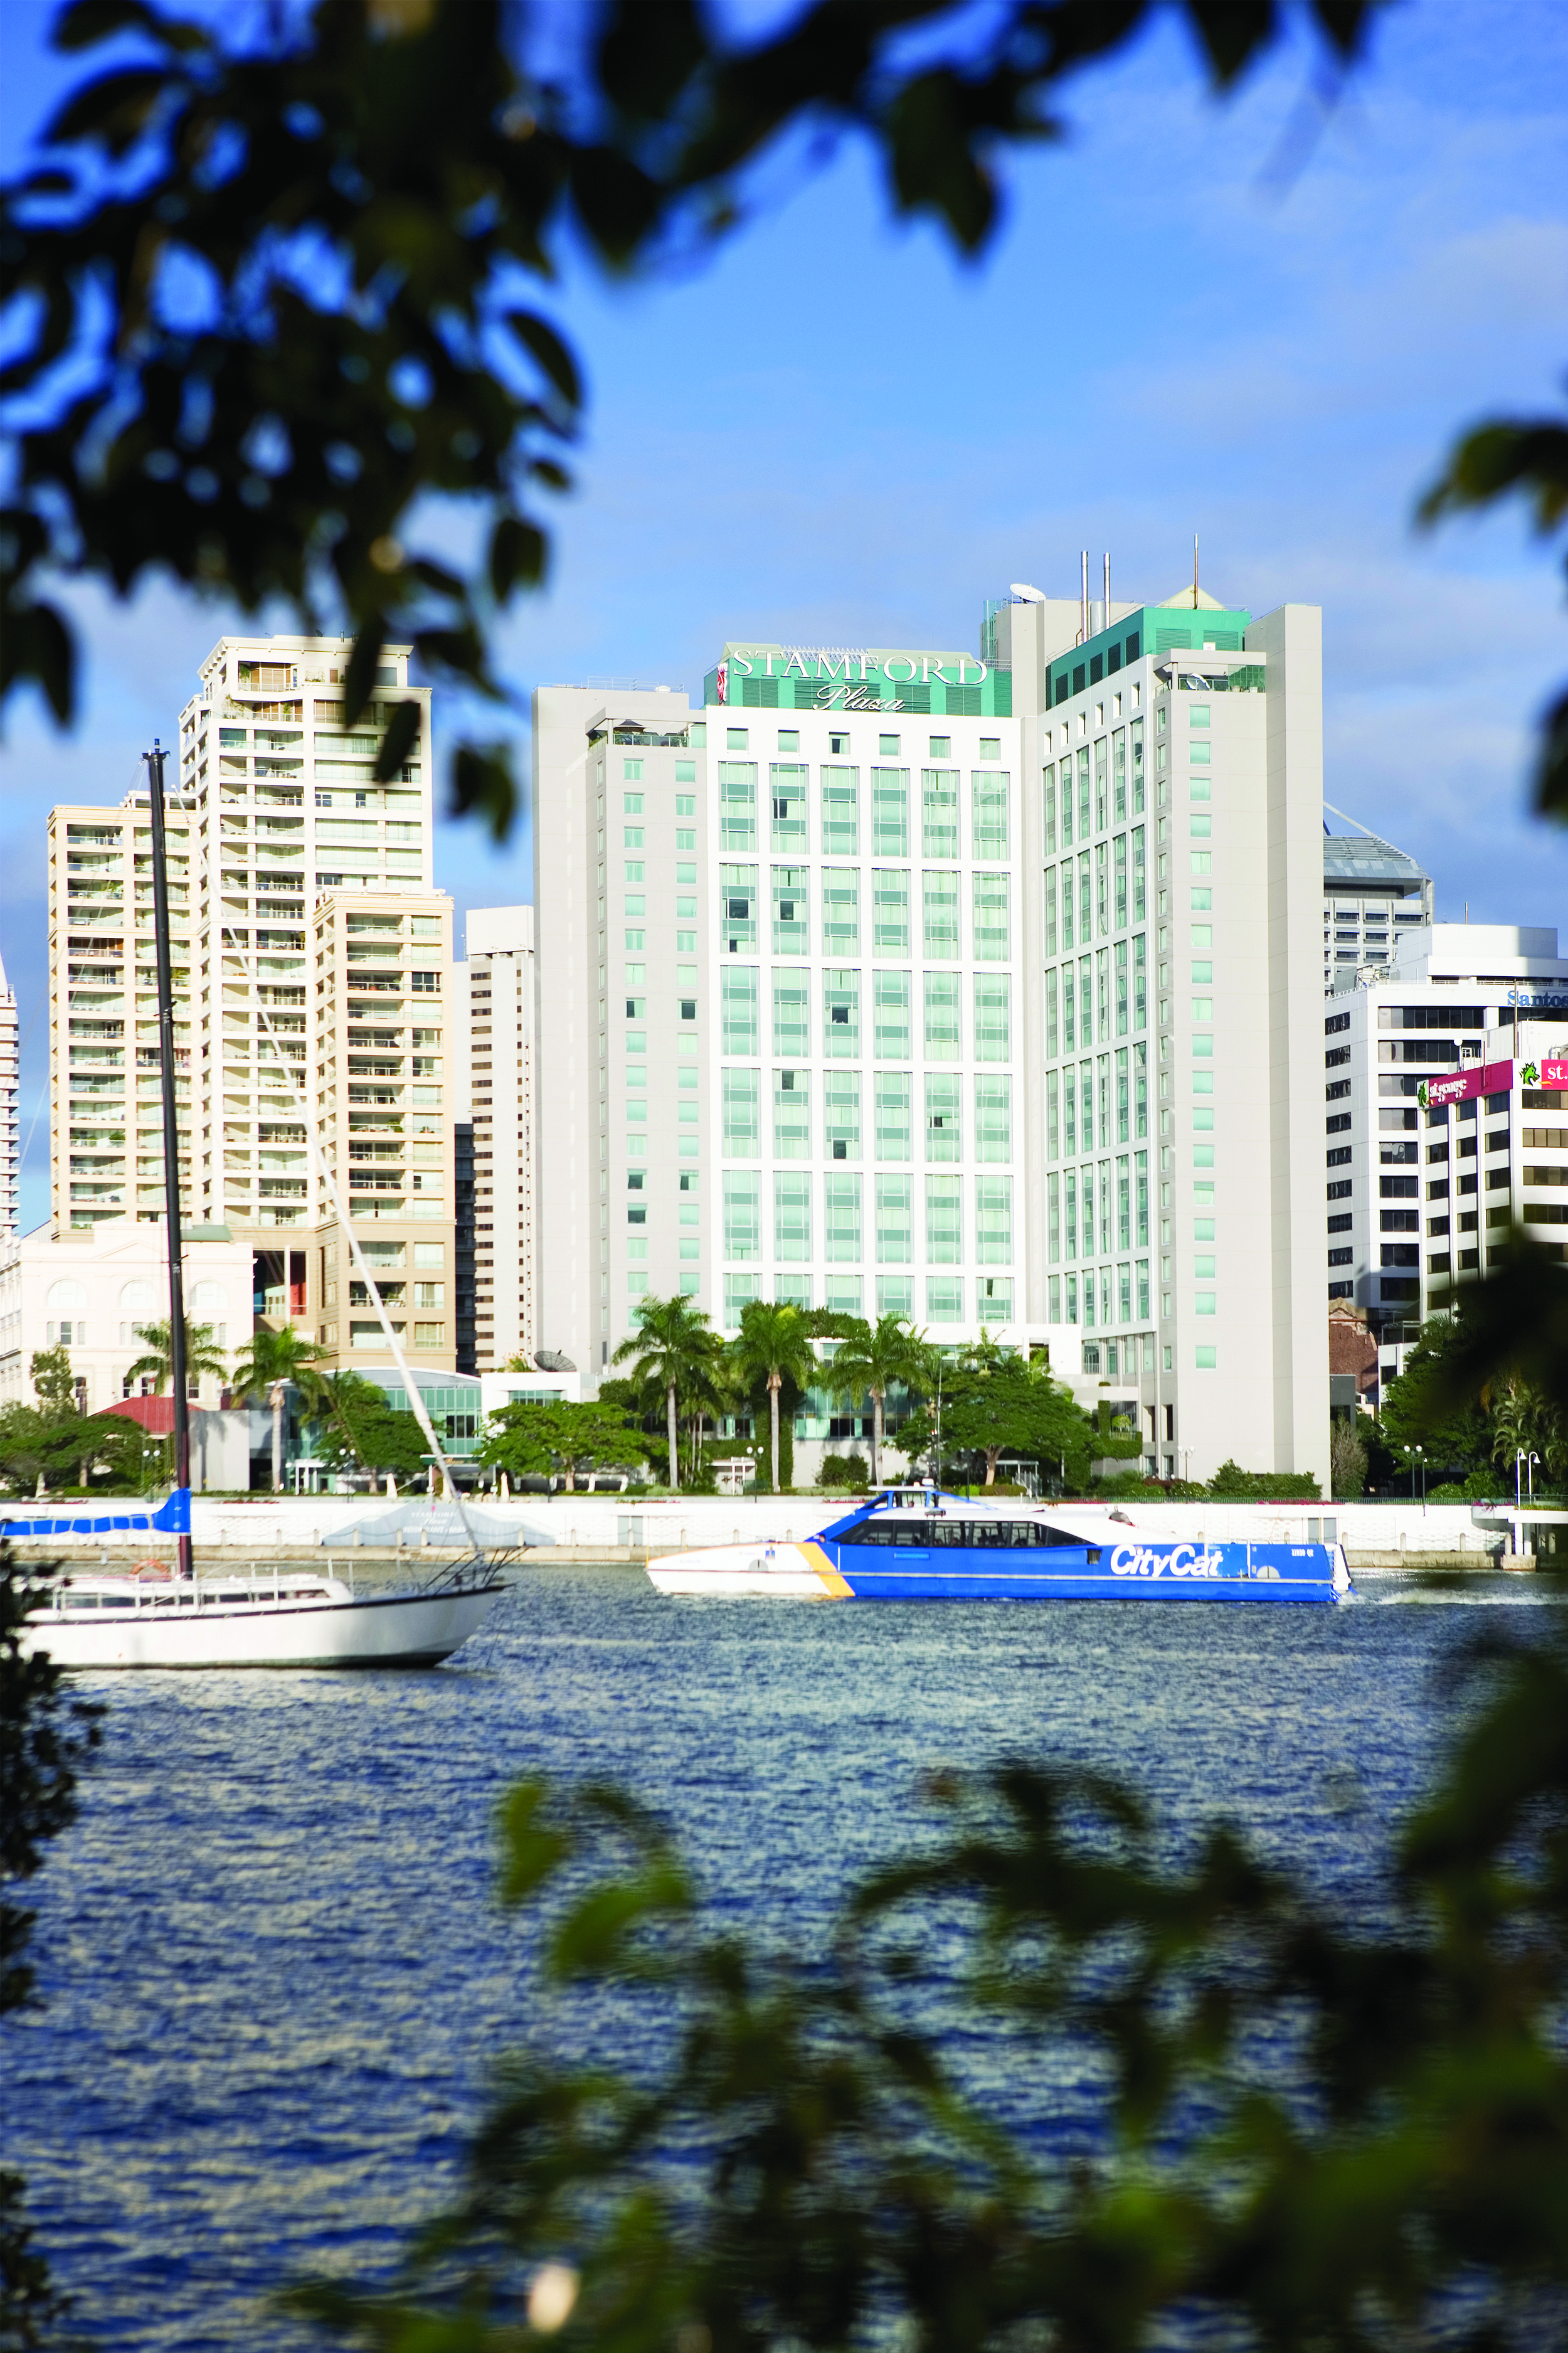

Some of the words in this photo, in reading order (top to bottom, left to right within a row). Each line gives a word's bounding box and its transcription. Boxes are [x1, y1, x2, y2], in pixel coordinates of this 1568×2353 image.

[733, 649, 988, 684] STAMFORD
[813, 684, 905, 711] Plaza
[1507, 991, 1568, 1007] Santos
[1110, 1544, 1223, 1577] CityCat
